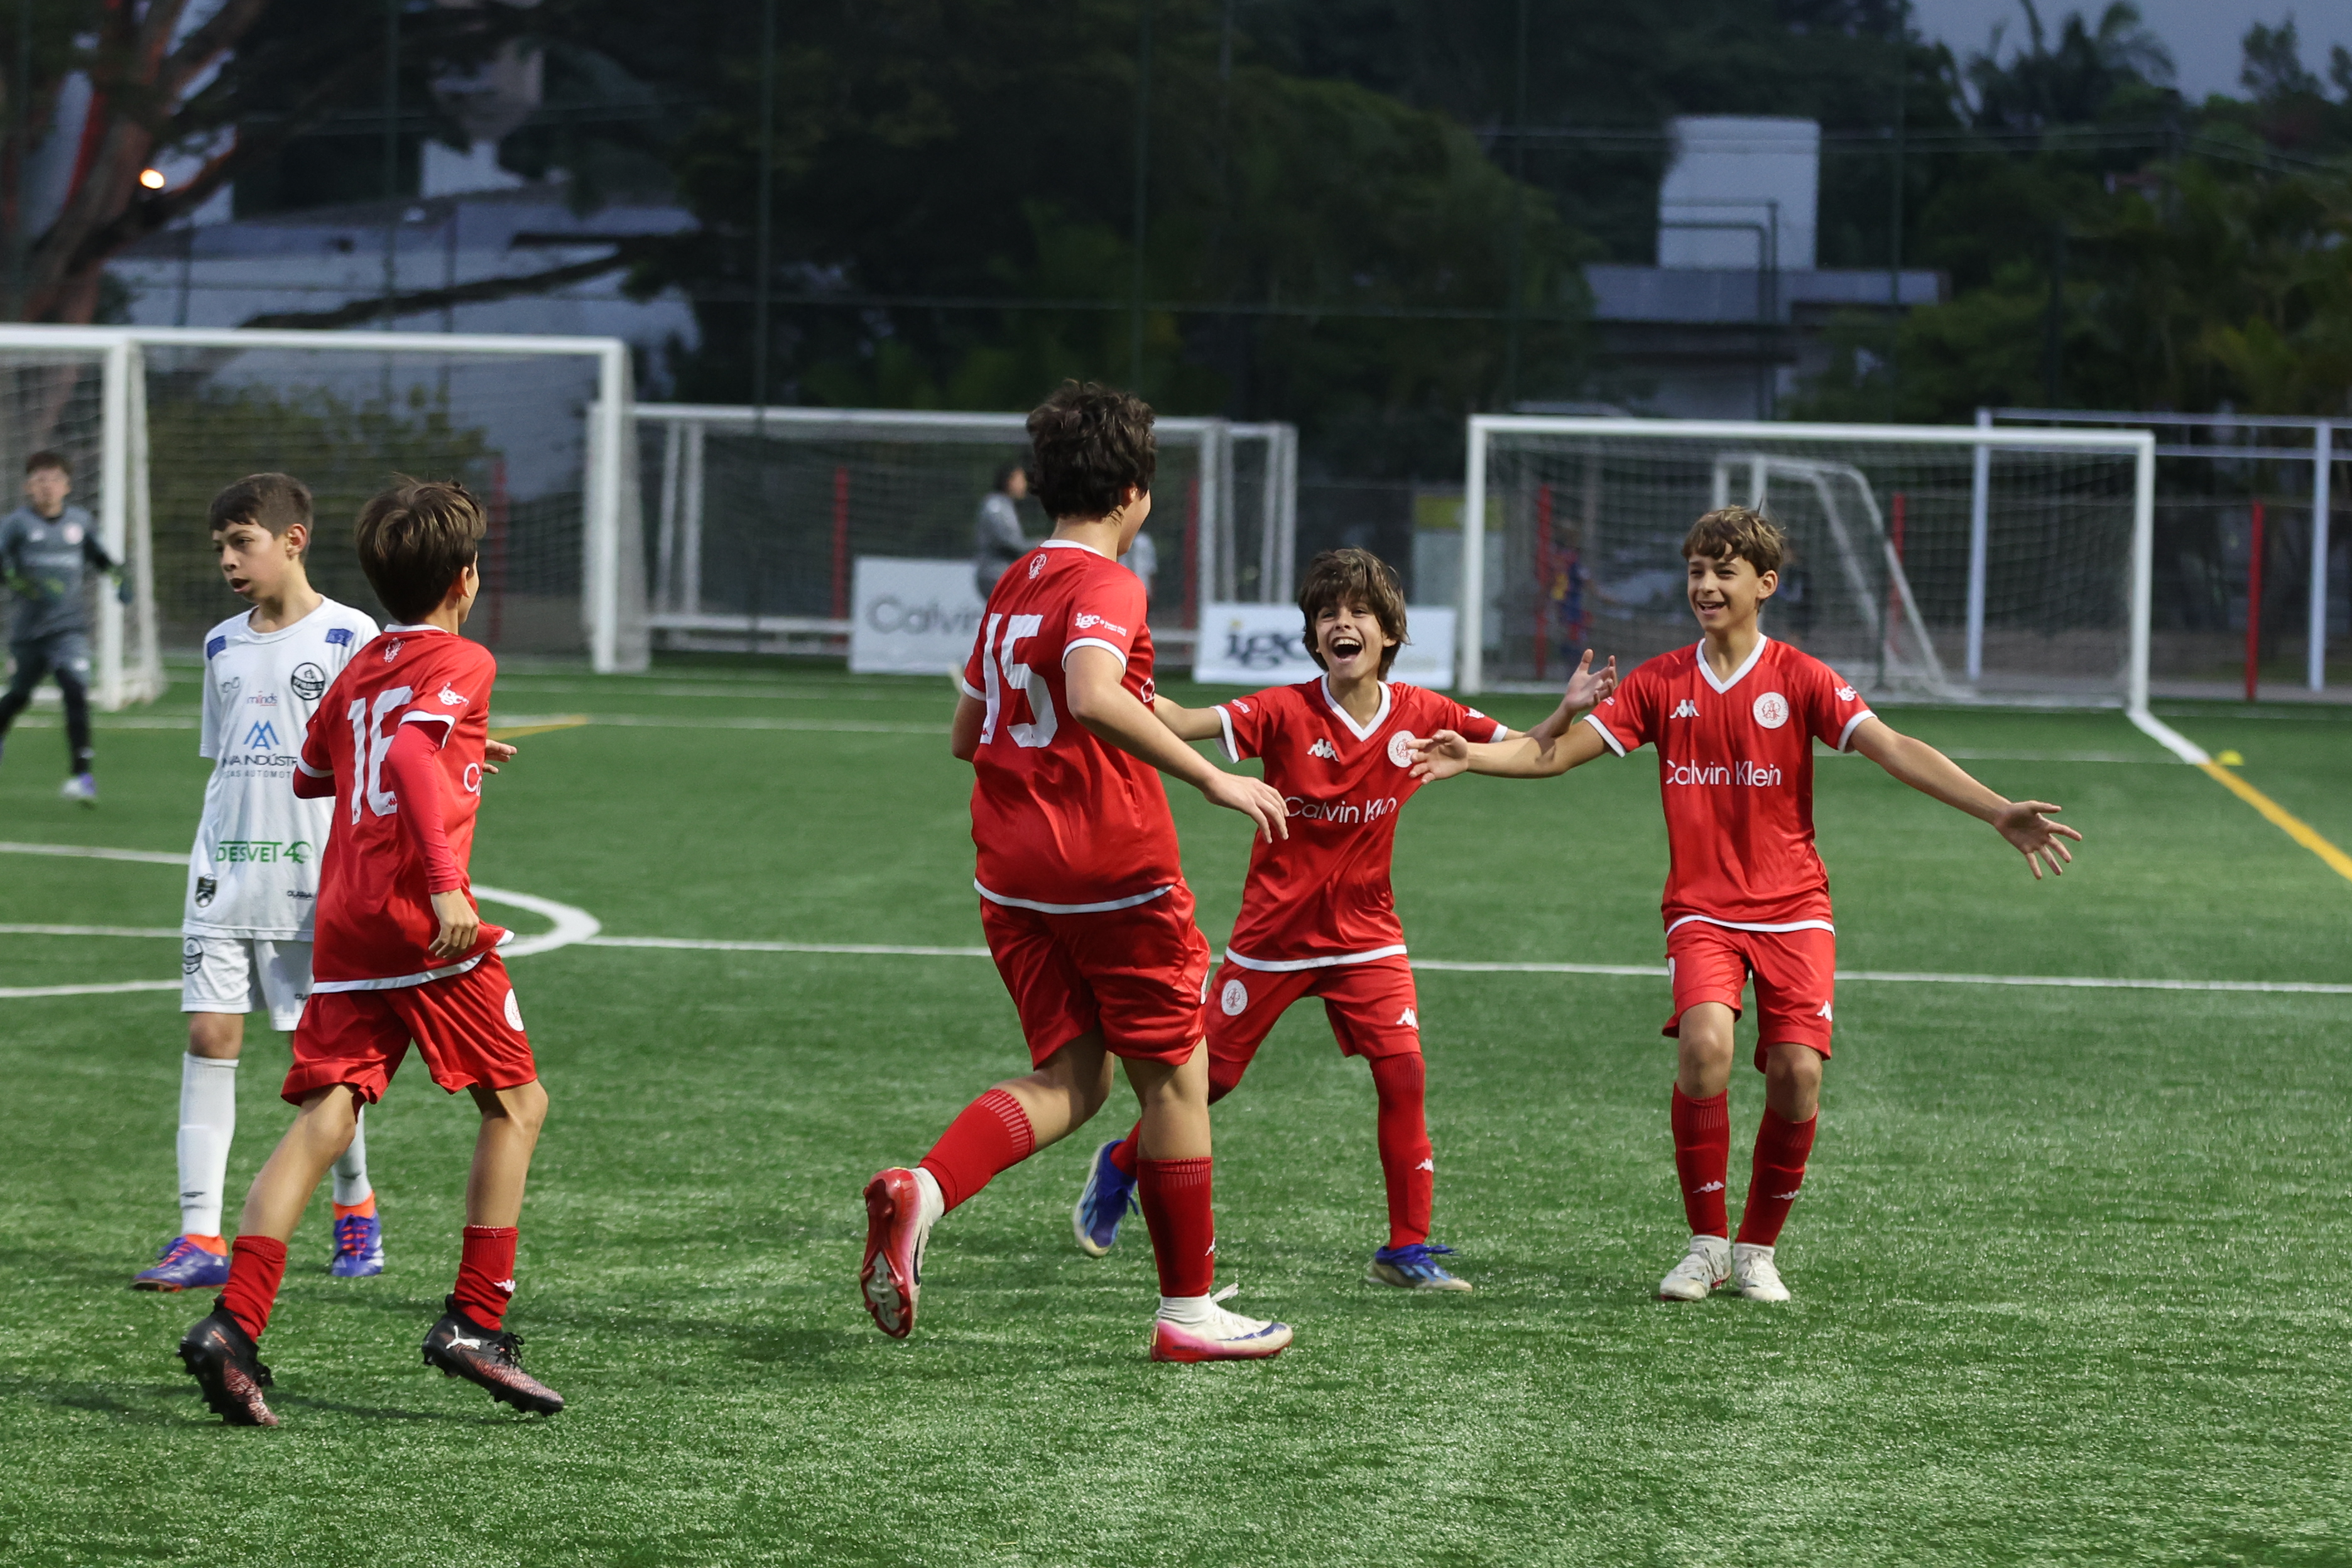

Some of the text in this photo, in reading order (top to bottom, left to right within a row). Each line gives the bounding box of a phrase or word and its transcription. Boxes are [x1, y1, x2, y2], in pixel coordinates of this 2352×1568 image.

[1075, 612, 1101, 629] igc
[980, 612, 1059, 748] 15
[244, 753, 298, 766] INDÚSTR
[244, 770, 291, 778] AUTOMOT
[1736, 760, 1782, 787] Klein
[1285, 796, 1359, 824] Calvin
[215, 841, 283, 863] DESVET
